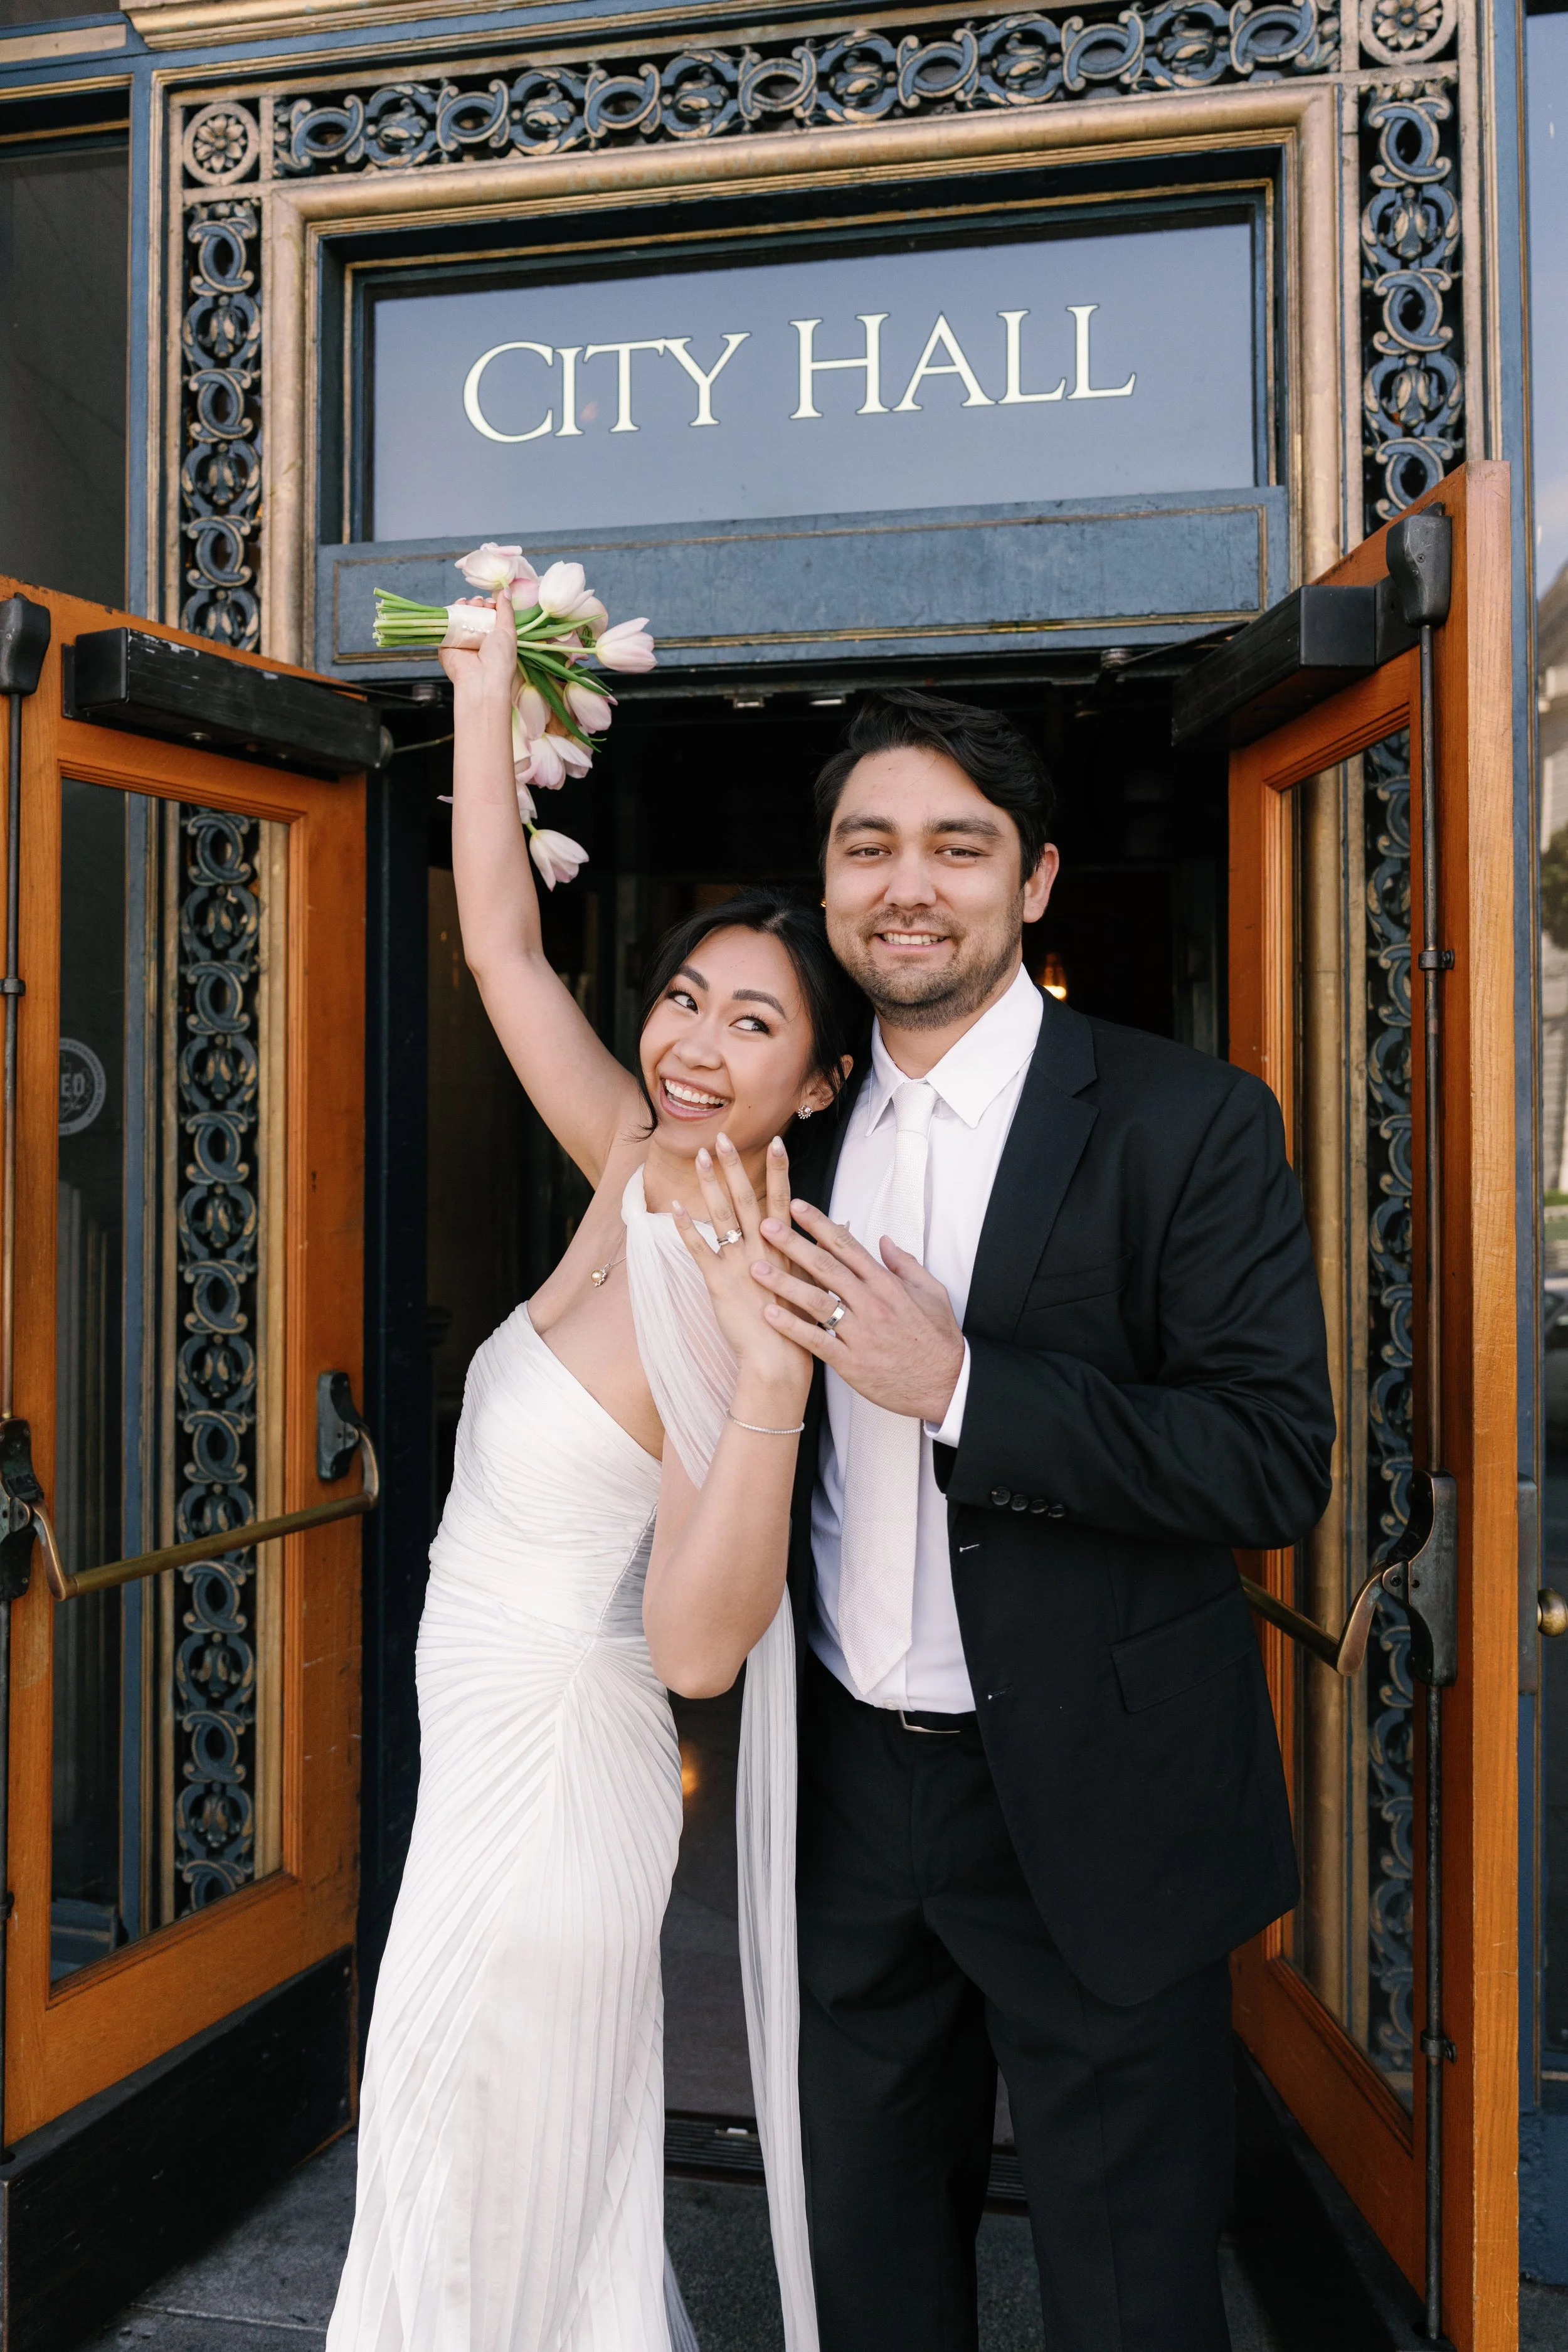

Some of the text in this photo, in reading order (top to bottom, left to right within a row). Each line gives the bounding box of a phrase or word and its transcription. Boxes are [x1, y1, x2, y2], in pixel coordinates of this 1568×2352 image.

[463, 305, 1136, 443] CITY HALL
[61, 1073, 85, 1096] ED
